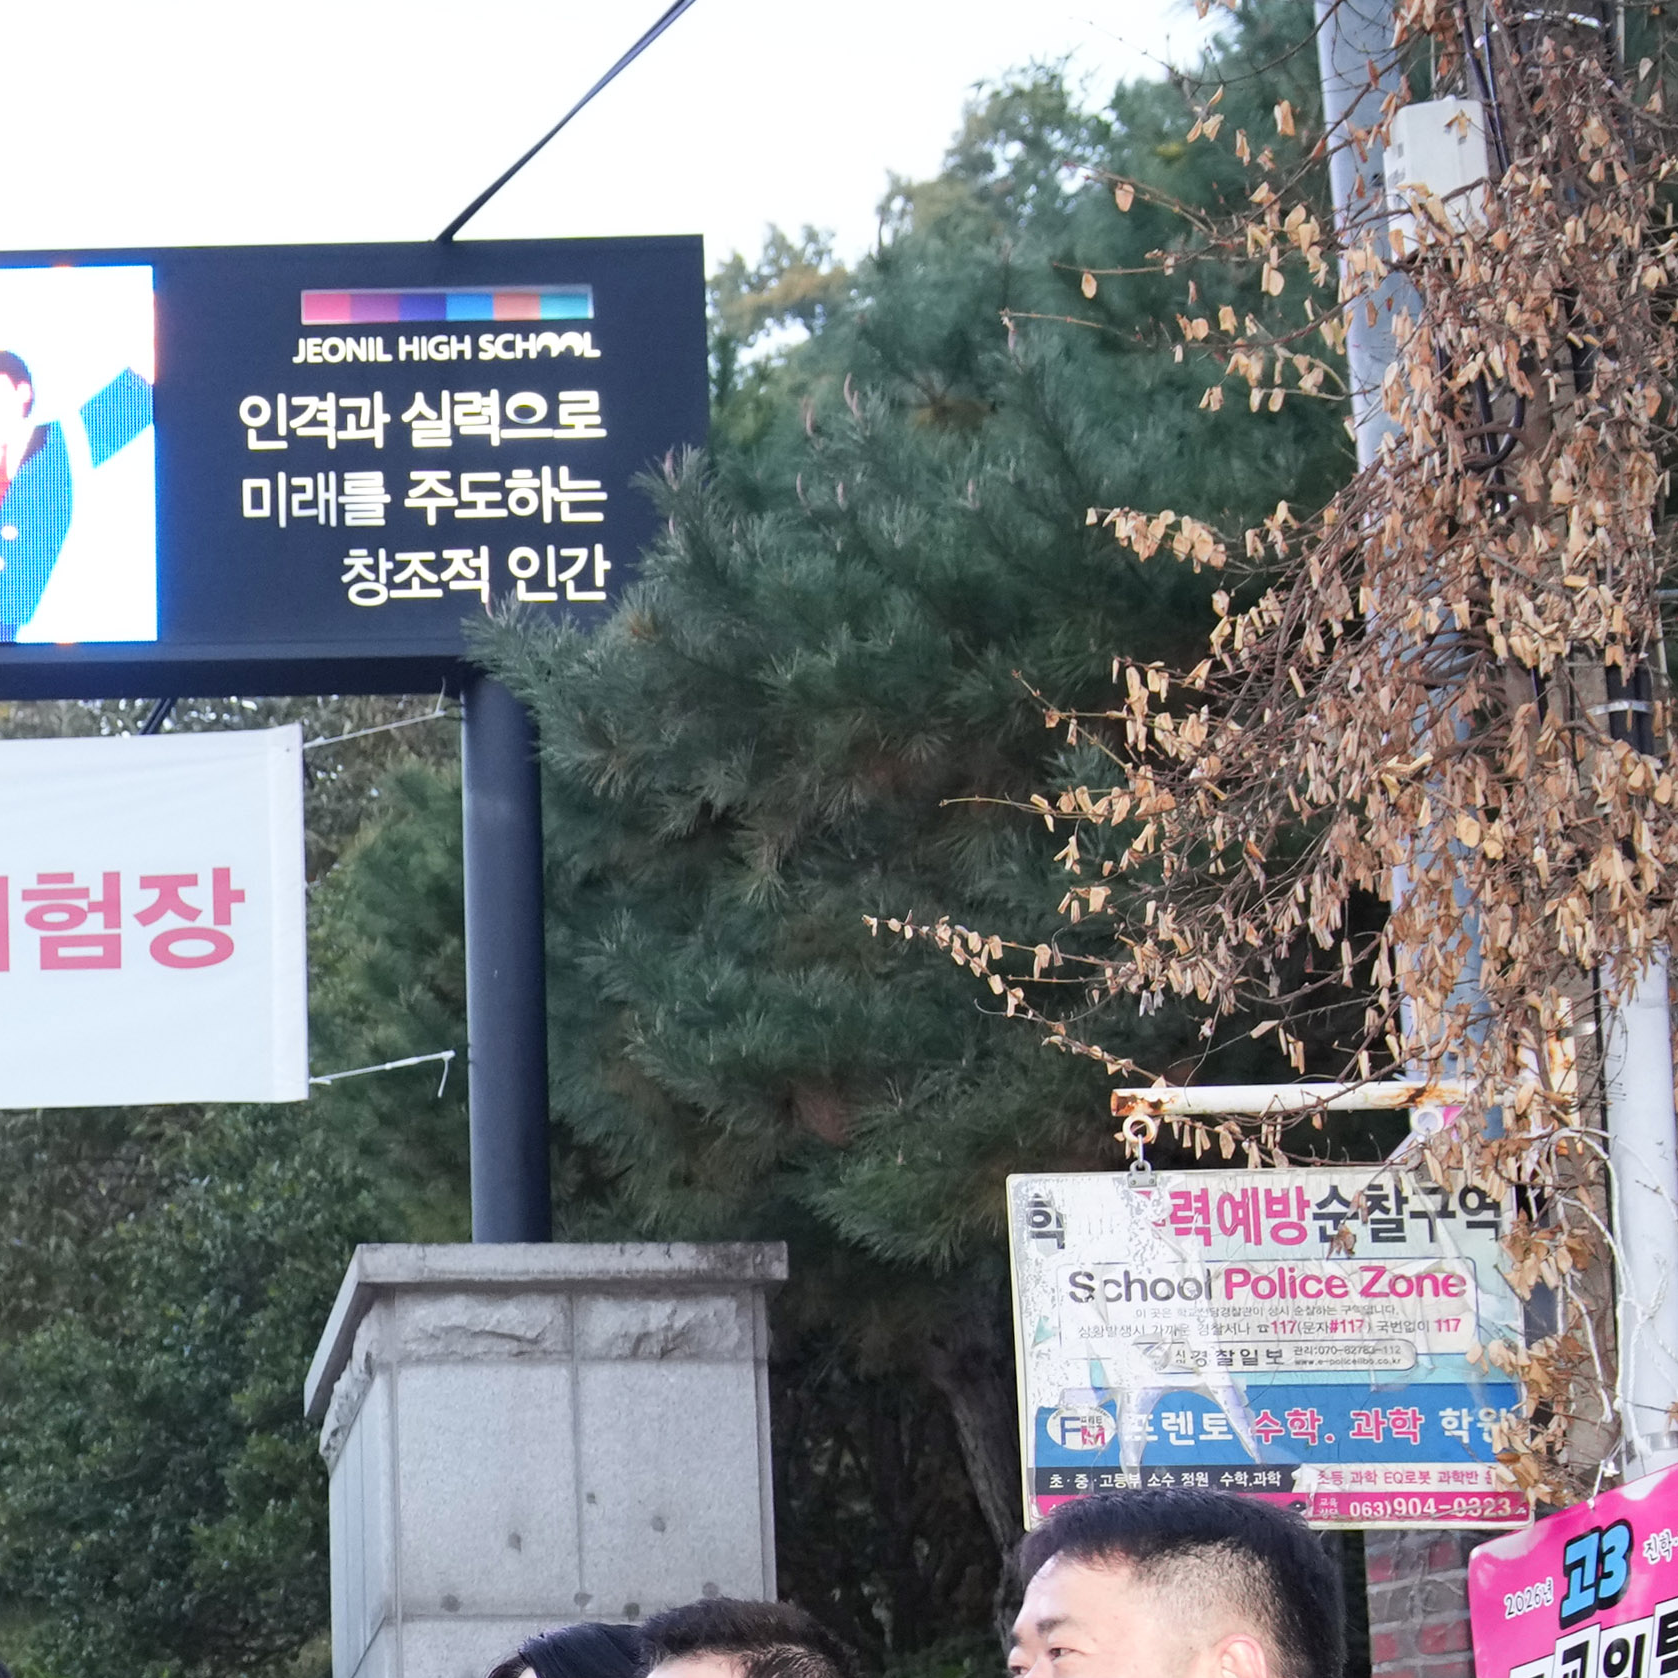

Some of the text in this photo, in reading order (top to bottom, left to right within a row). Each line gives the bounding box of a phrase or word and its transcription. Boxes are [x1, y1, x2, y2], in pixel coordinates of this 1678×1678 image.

[292, 336, 392, 363] JEONIL
[398, 333, 471, 361] HIGH
[239, 389, 607, 450] 인격과 실력으로
[242, 465, 608, 528] 미래를 주도하는
[340, 543, 612, 607] 창조적 인간
[1068, 1265, 1466, 1303] School Police Zone
[1267, 1305, 1290, 1317] 상시
[1294, 1304, 1338, 1316] 순찰하는
[1376, 1319, 1429, 1333] 국번없이
[1434, 1318, 1461, 1332] 117
[1349, 1406, 1425, 1445] 과학
[1147, 1472, 1175, 1488] 소수
[1181, 1471, 1209, 1487] 정원
[1349, 1470, 1378, 1485] 과학
[1384, 1469, 1431, 1485] EQ로봇
[1437, 1469, 1479, 1485] 과학반
[1560, 1521, 1632, 1624] 고3
[1505, 1580, 1552, 1616] 2026년
